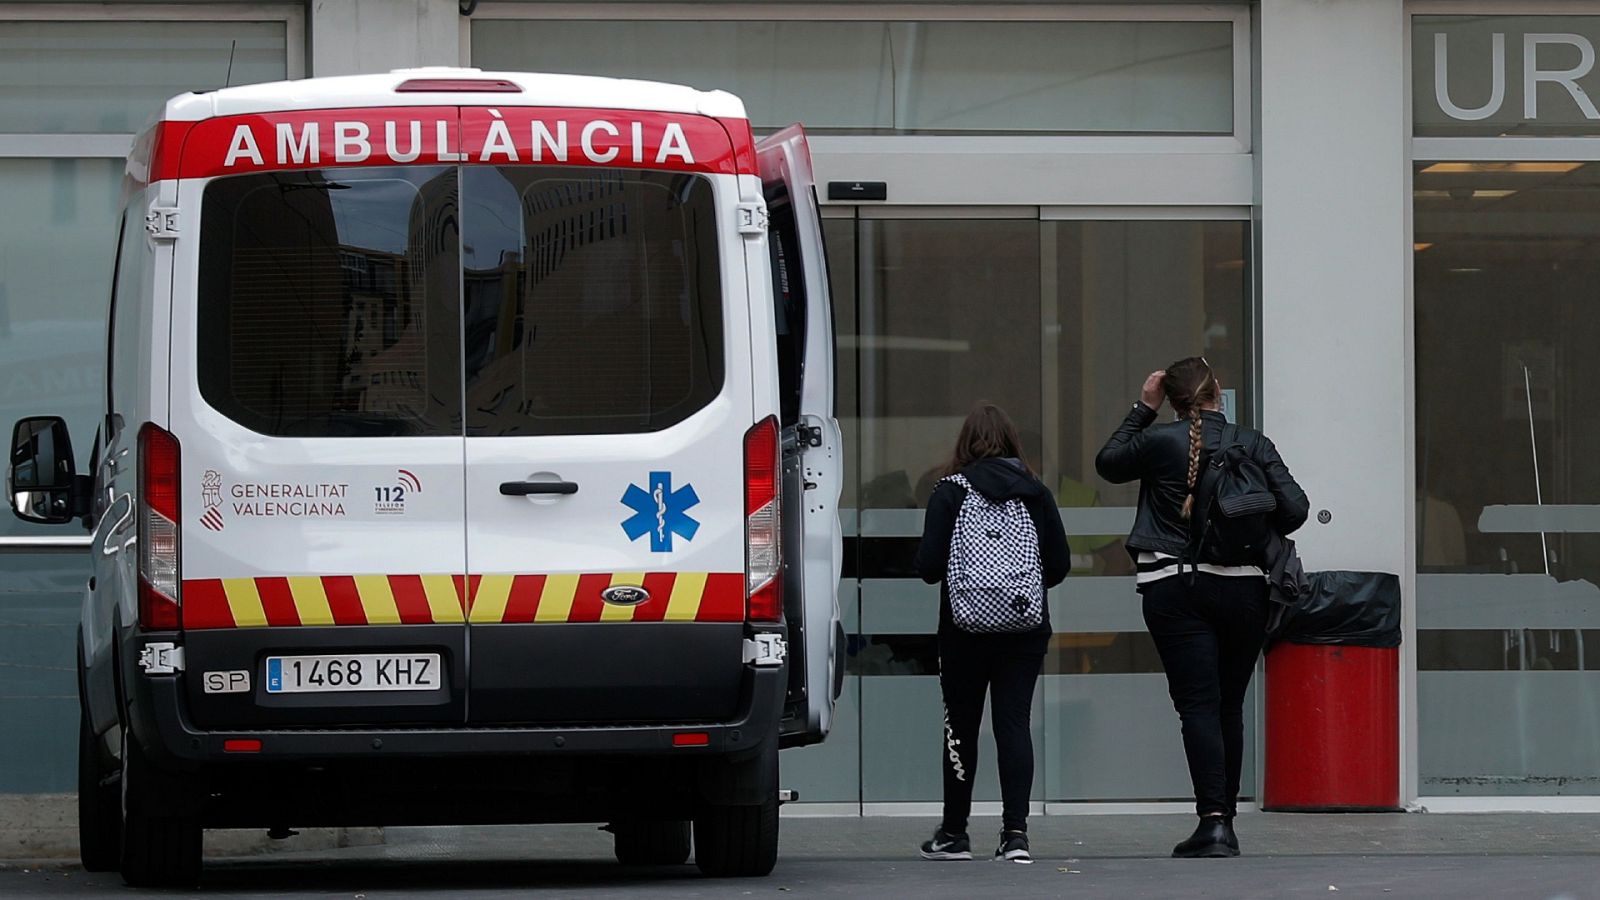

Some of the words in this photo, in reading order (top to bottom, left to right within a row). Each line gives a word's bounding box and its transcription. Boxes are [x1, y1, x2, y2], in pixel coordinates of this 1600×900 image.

[1434, 33, 1600, 120] UR
[224, 109, 695, 167] AMBULÀNCIA
[231, 484, 348, 498] GENERALITAT
[375, 486, 404, 502] 112
[232, 503, 346, 516] VALENCIANA
[611, 588, 638, 601] Ford
[293, 660, 362, 687] 1468
[376, 659, 431, 685] KHZ
[208, 673, 245, 691] SP
[271, 678, 278, 686] E
